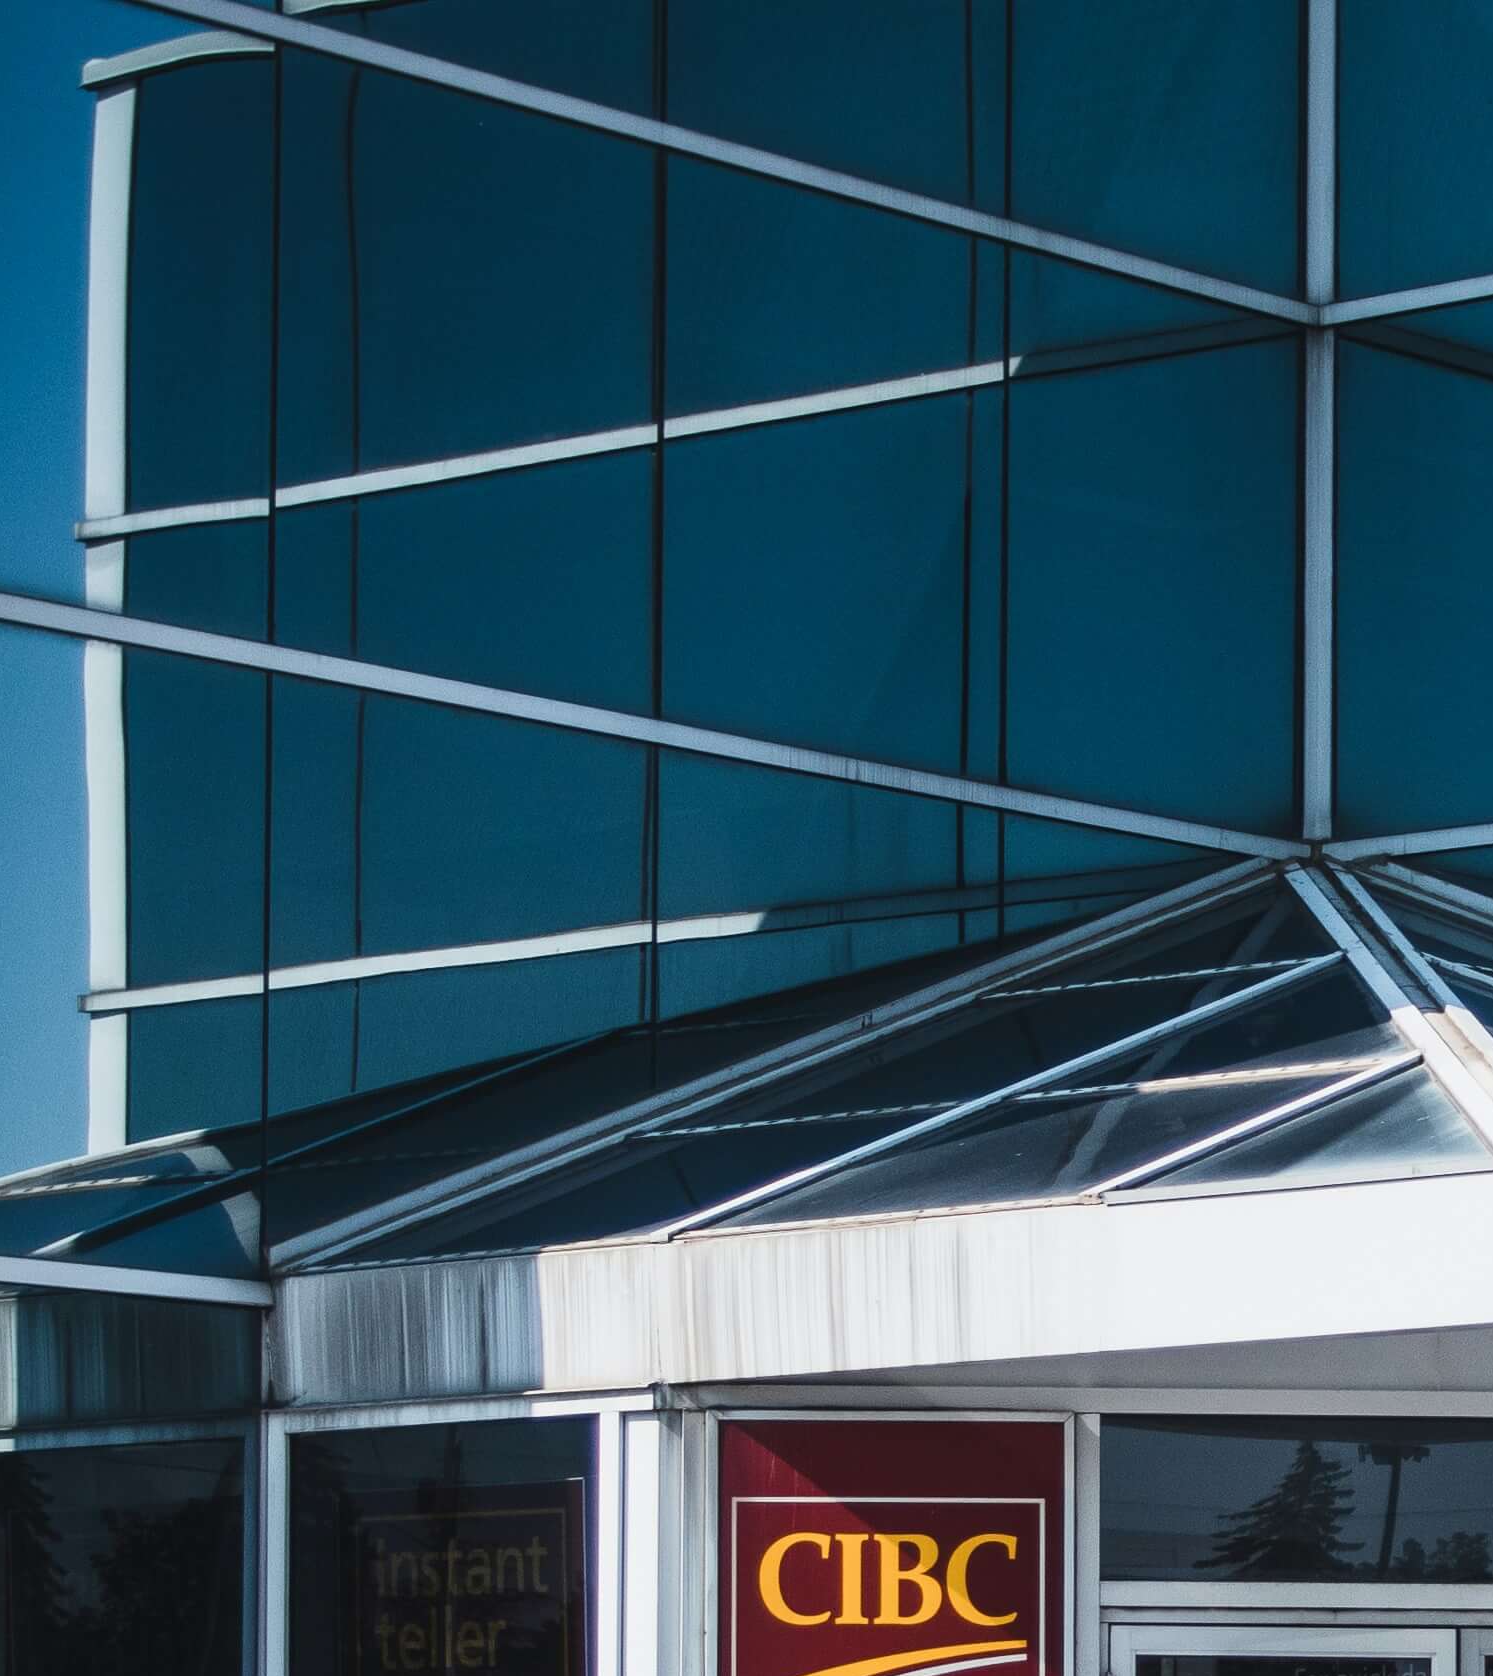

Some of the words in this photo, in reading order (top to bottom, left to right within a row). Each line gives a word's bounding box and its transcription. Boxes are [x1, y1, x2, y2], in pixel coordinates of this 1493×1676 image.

[375, 1536, 549, 1597] instant
[759, 1532, 1018, 1626] CIBC
[375, 1604, 507, 1669] teller
